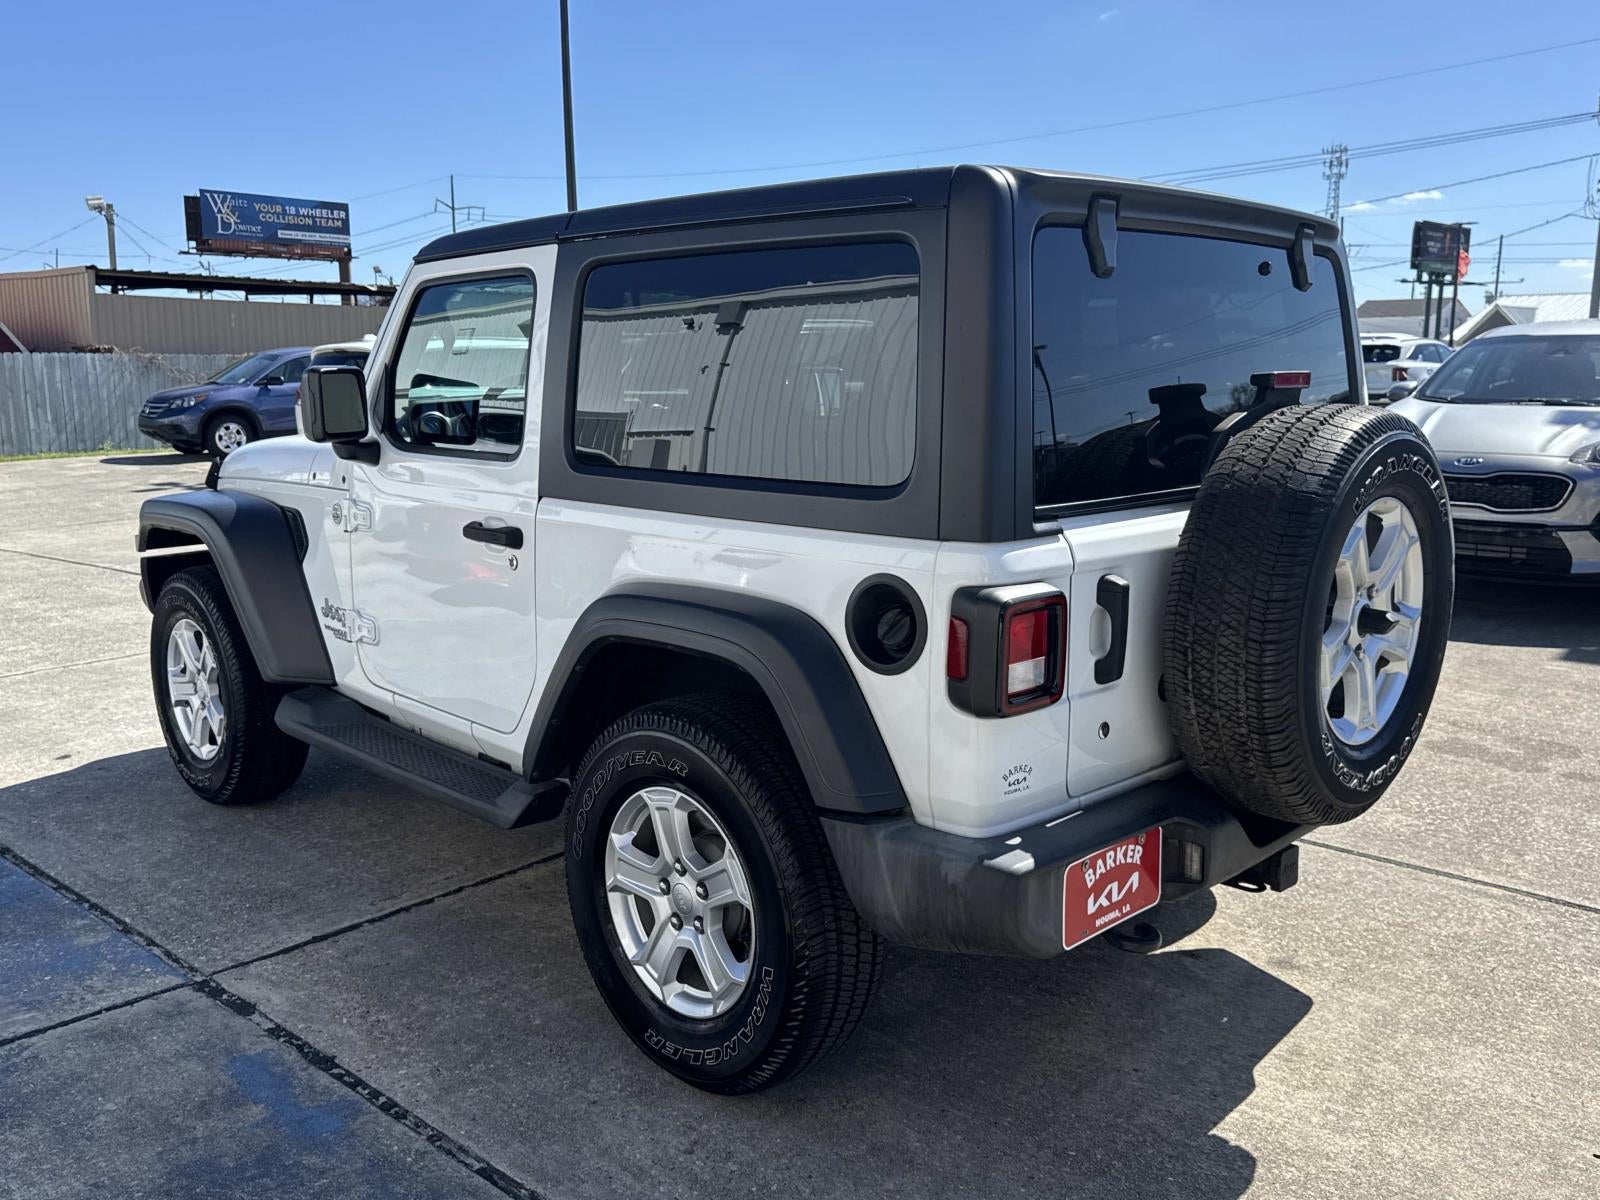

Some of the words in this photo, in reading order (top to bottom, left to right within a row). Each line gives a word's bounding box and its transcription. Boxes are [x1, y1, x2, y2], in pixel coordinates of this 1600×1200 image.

[253, 202, 283, 214] YOUR
[285, 205, 296, 215] 18
[298, 207, 346, 219] WHEELER
[259, 213, 313, 226] COLLISION
[315, 217, 343, 228] TEAM
[1353, 453, 1448, 522] WRANGLER
[1002, 763, 1033, 782] BARKER
[573, 750, 690, 860] GOODYEAR
[1084, 844, 1144, 889] BARKER
[1087, 871, 1140, 915] KIA
[1122, 903, 1131, 913] LA
[644, 966, 774, 1065] WRANGLER
